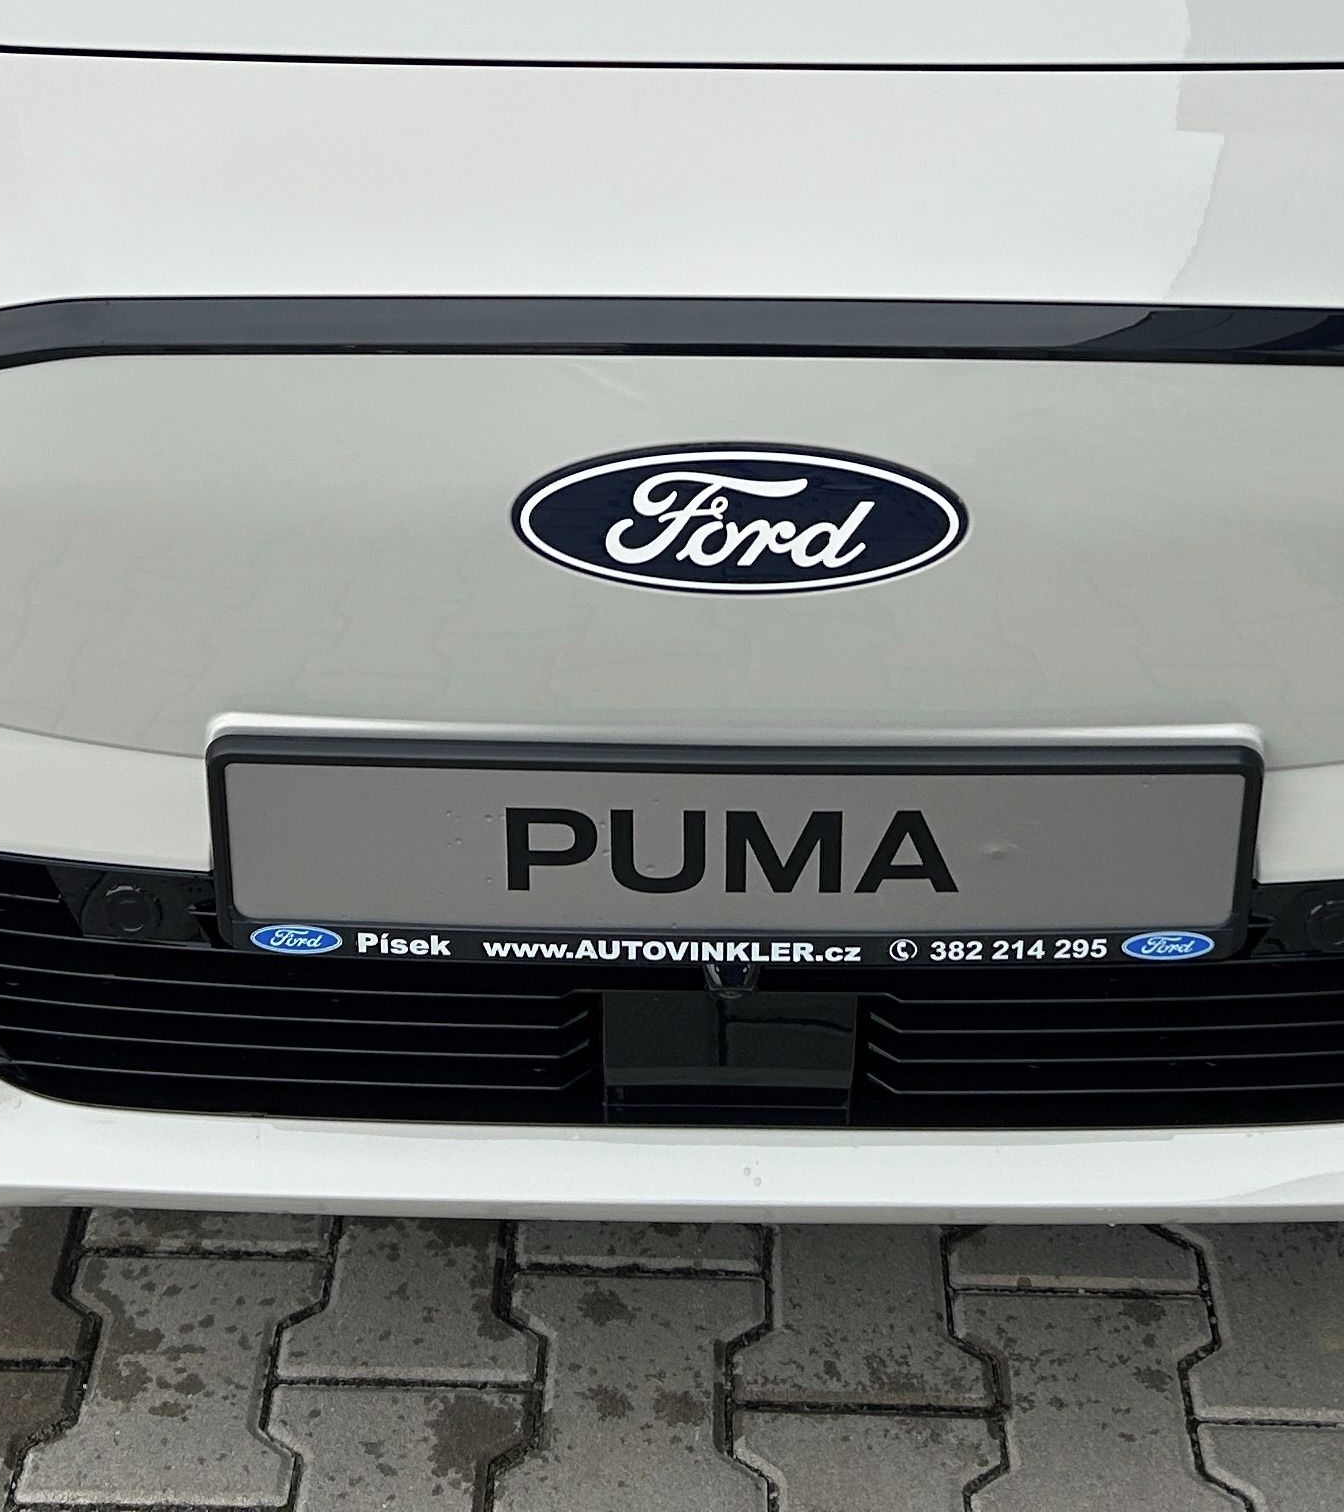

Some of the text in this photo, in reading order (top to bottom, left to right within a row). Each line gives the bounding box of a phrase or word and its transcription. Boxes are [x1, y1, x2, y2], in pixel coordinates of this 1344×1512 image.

[605, 471, 876, 568] Ford
[505, 807, 960, 893] PUMA
[357, 932, 451, 956] Písek
[483, 939, 861, 962] www.AUTOVINKLER.cz
[930, 939, 982, 961] 382
[992, 939, 1046, 960] 214
[1054, 938, 1108, 959] 295
